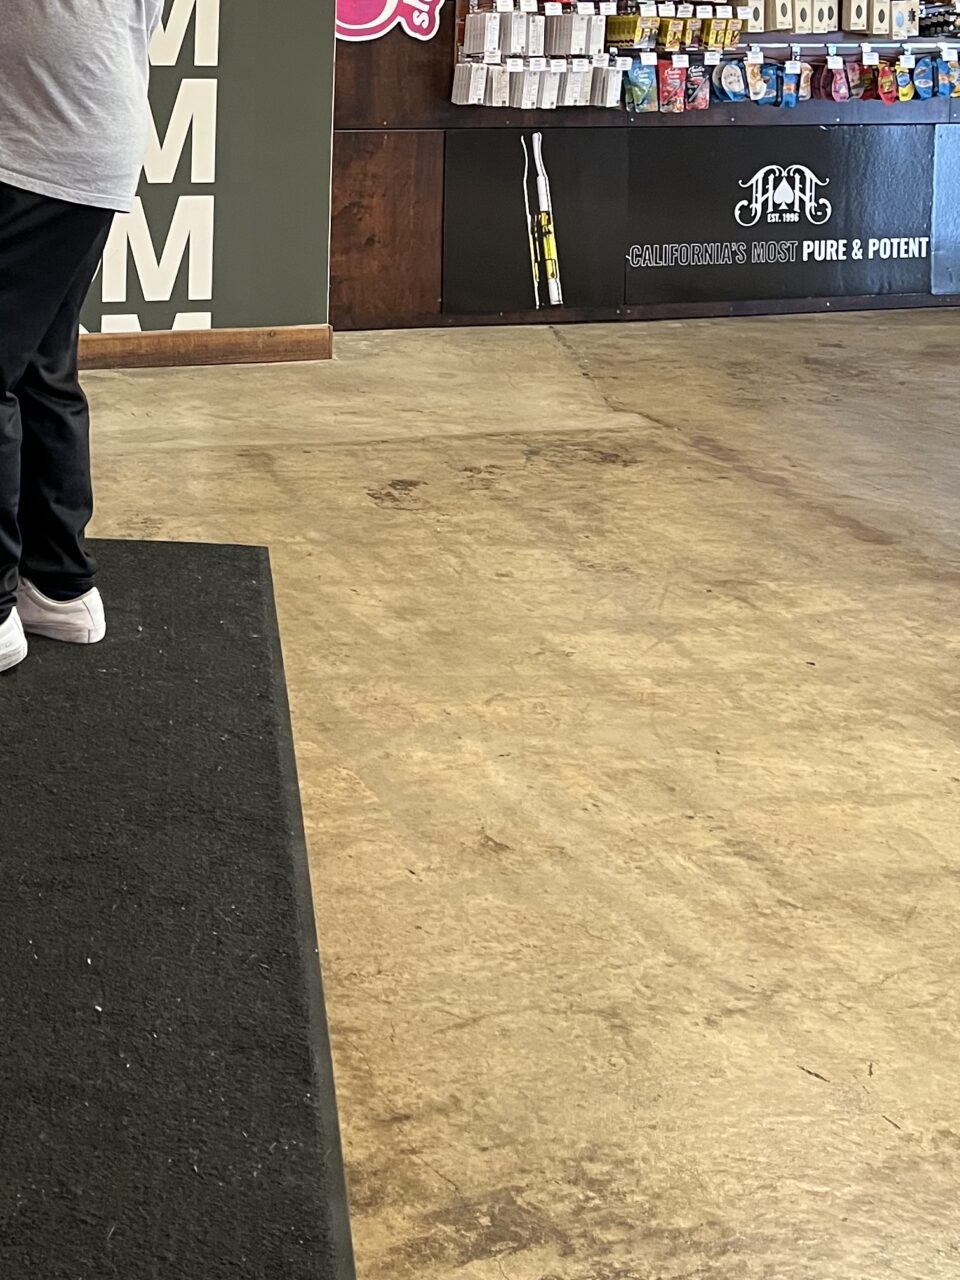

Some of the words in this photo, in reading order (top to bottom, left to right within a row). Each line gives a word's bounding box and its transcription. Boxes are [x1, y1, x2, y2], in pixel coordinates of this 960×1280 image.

[767, 213, 781, 223] EST.
[782, 212, 800, 223] 1996
[629, 241, 747, 267] CALIFORNIA'S
[751, 240, 798, 264] MOST
[802, 239, 847, 261] PURE
[851, 240, 864, 260] &
[868, 237, 929, 260] POTENT
